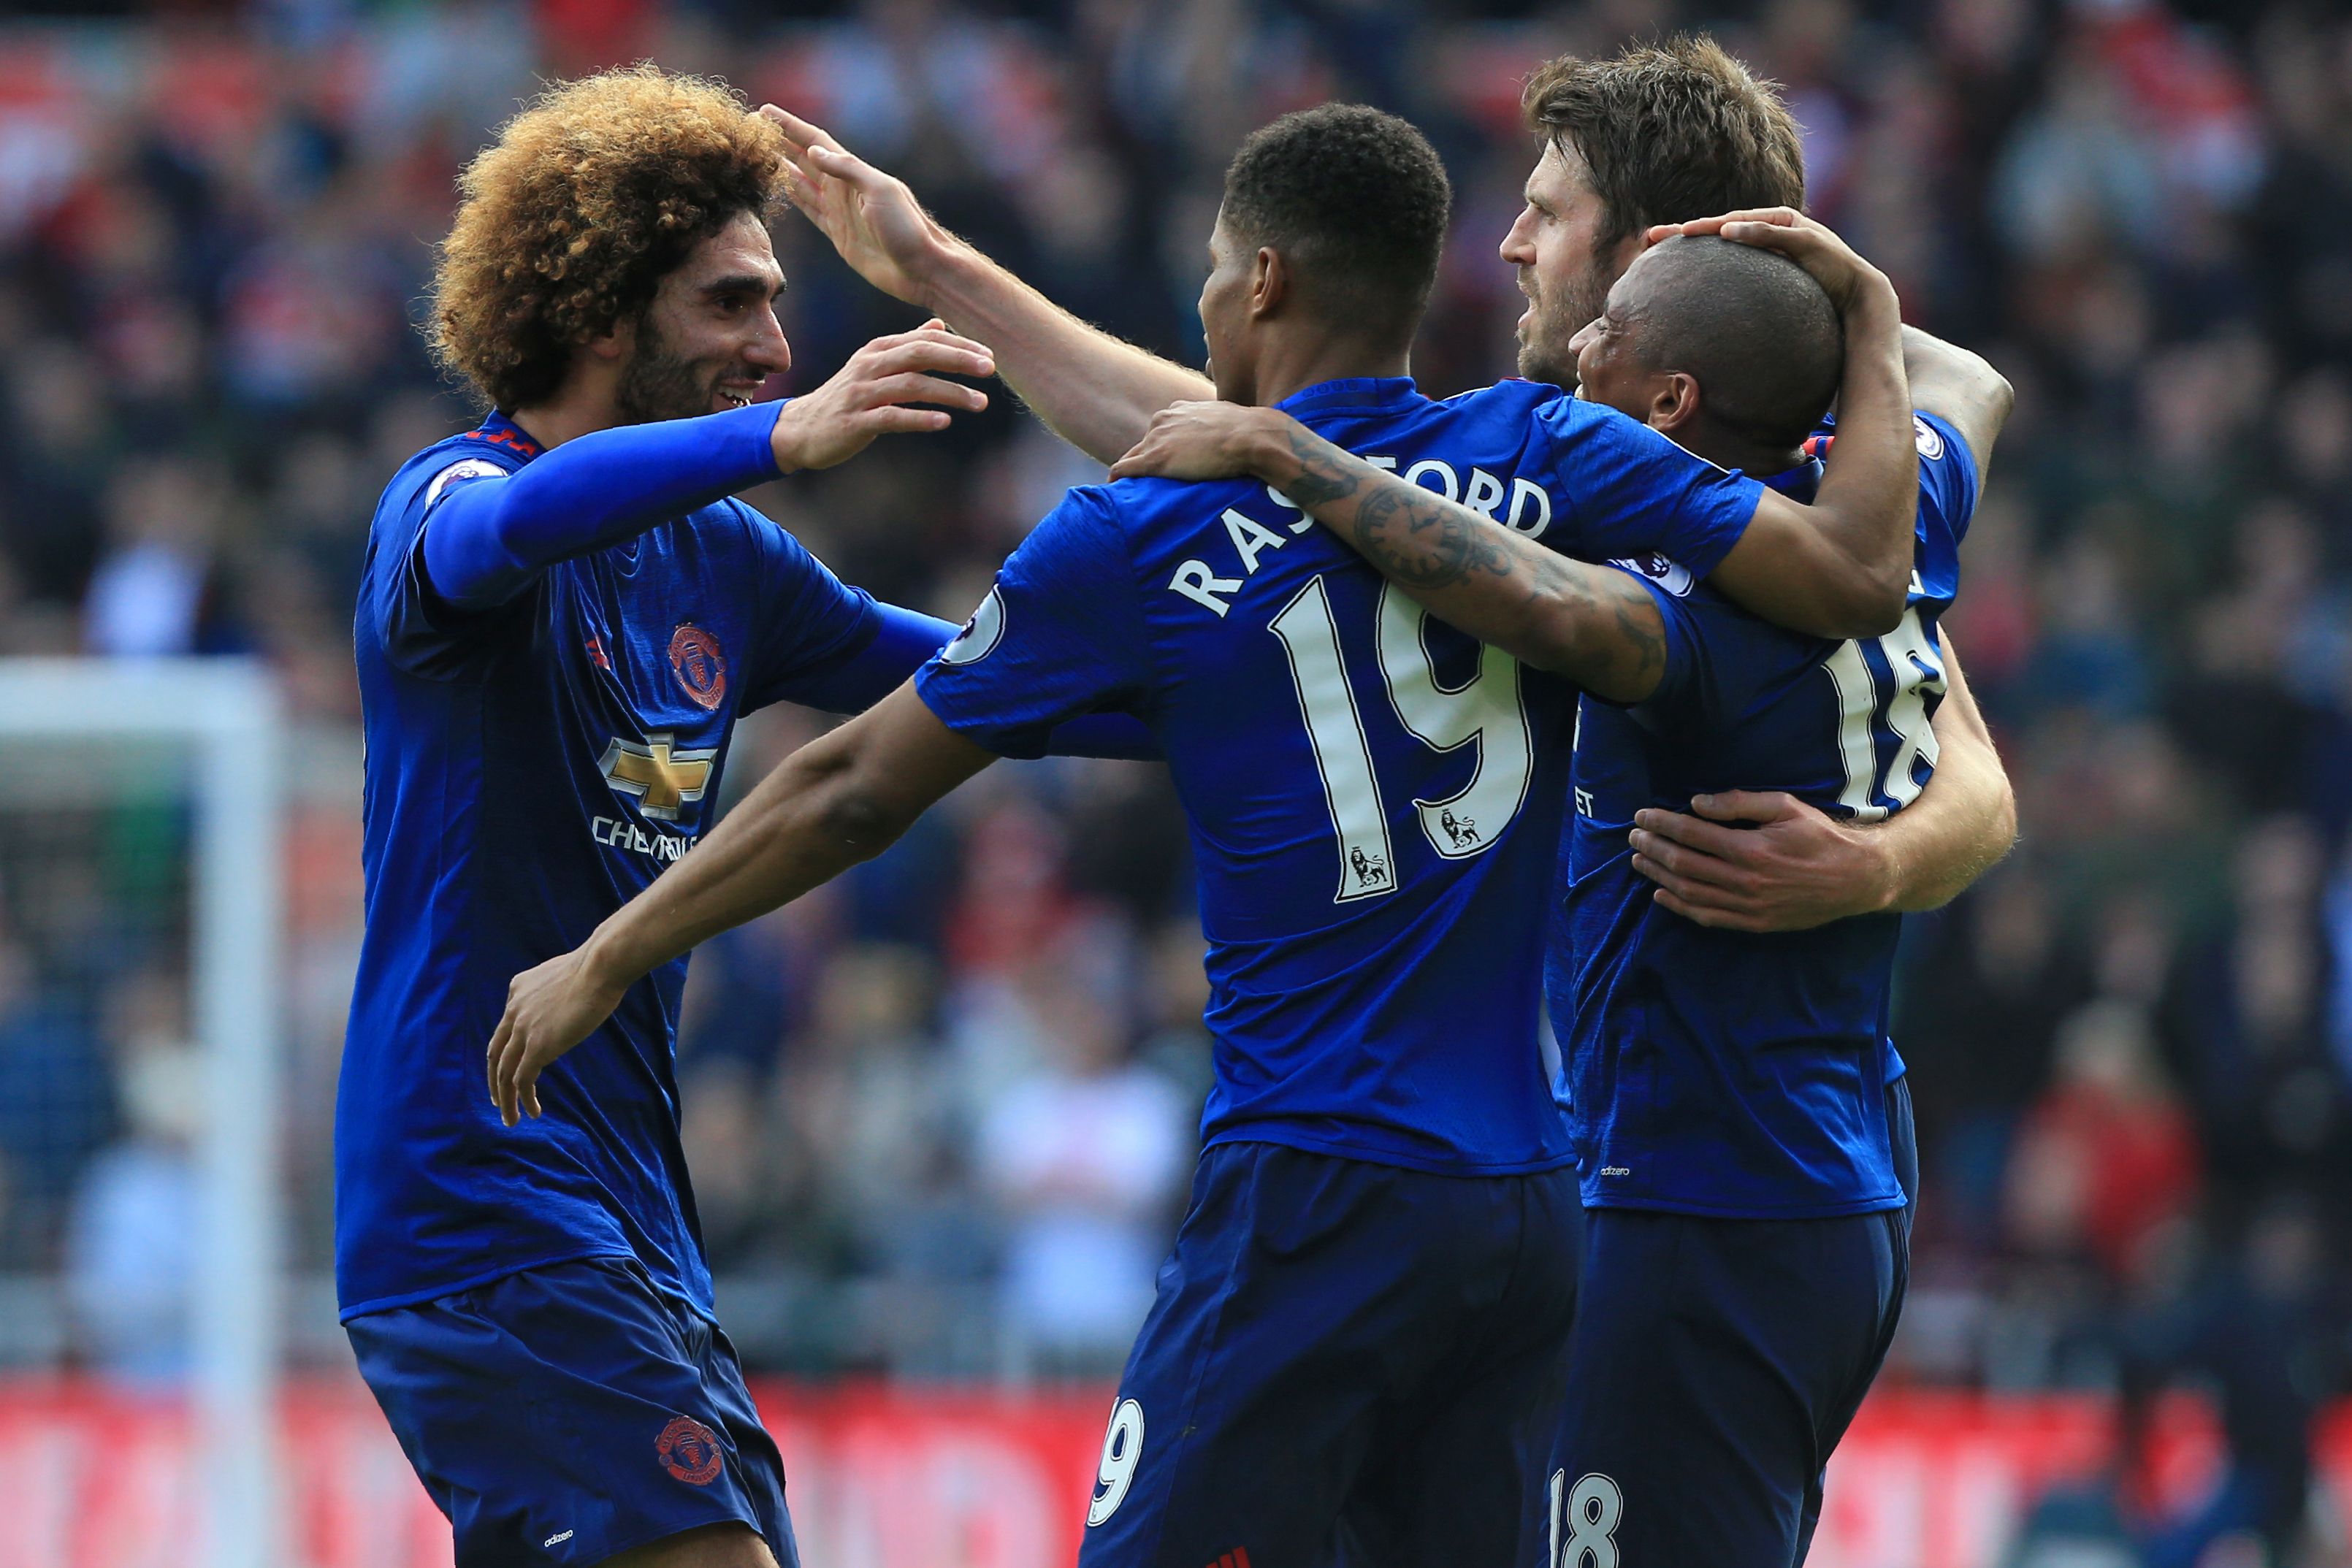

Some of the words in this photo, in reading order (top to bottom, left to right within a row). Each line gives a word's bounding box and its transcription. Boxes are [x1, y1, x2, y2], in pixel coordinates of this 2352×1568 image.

[1167, 454, 1552, 619] RASORD
[1267, 571, 1535, 905] 19
[1820, 605, 1948, 819] 18
[682, 1466, 717, 1481] UNITED
[1086, 1396, 1145, 1527] 9
[1549, 1467, 1624, 1568] 18
[544, 1529, 573, 1548] adizero
